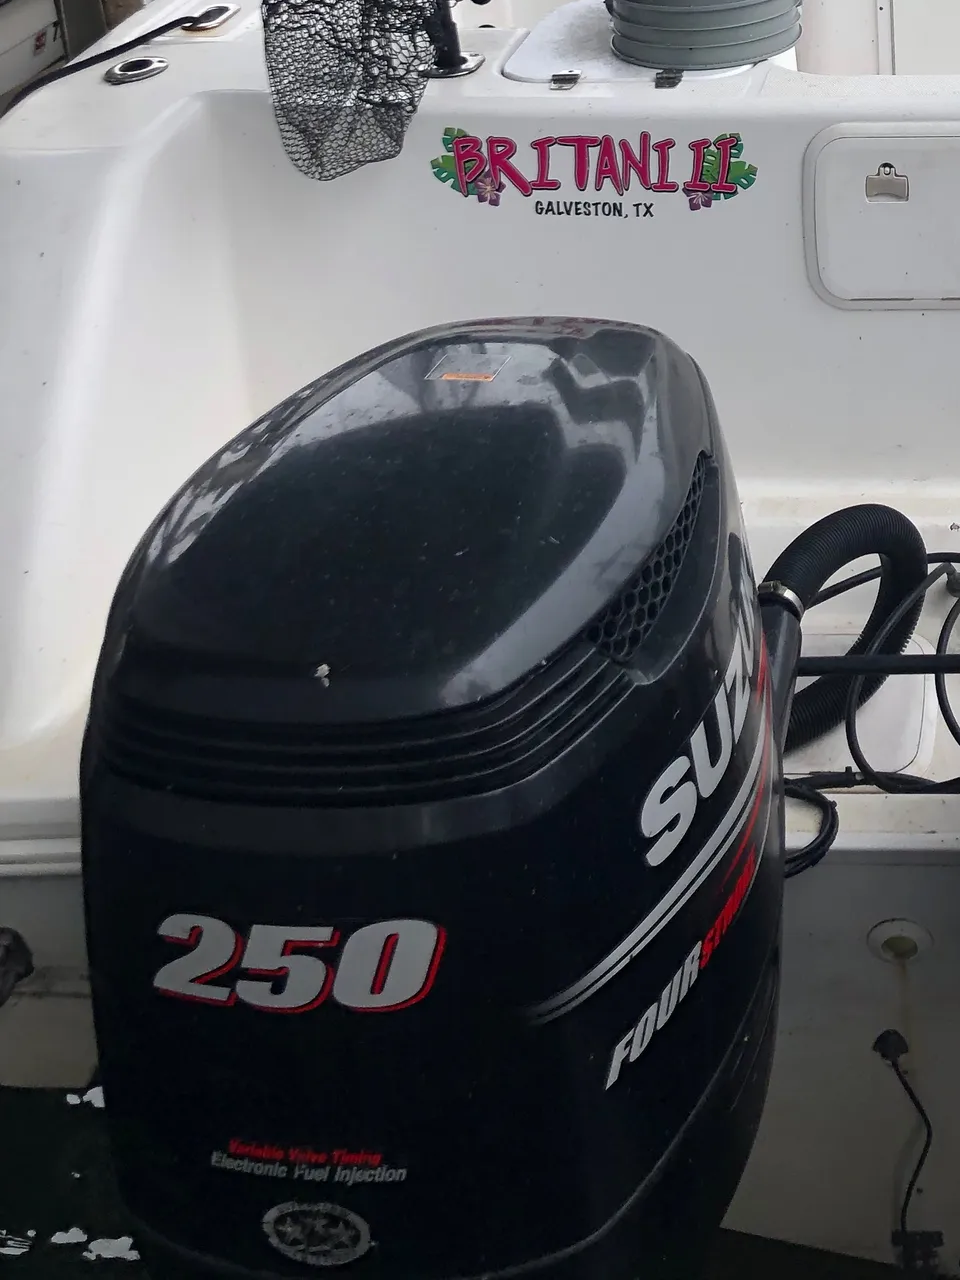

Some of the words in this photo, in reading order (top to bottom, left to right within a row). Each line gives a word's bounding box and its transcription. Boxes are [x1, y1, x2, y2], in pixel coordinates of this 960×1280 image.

[534, 200, 629, 219] GALVESTON,
[633, 201, 655, 218] TX
[152, 912, 448, 1014] 250
[211, 1149, 288, 1178] Electronic
[293, 1163, 331, 1182] Fuel
[334, 1164, 408, 1187] Injection
